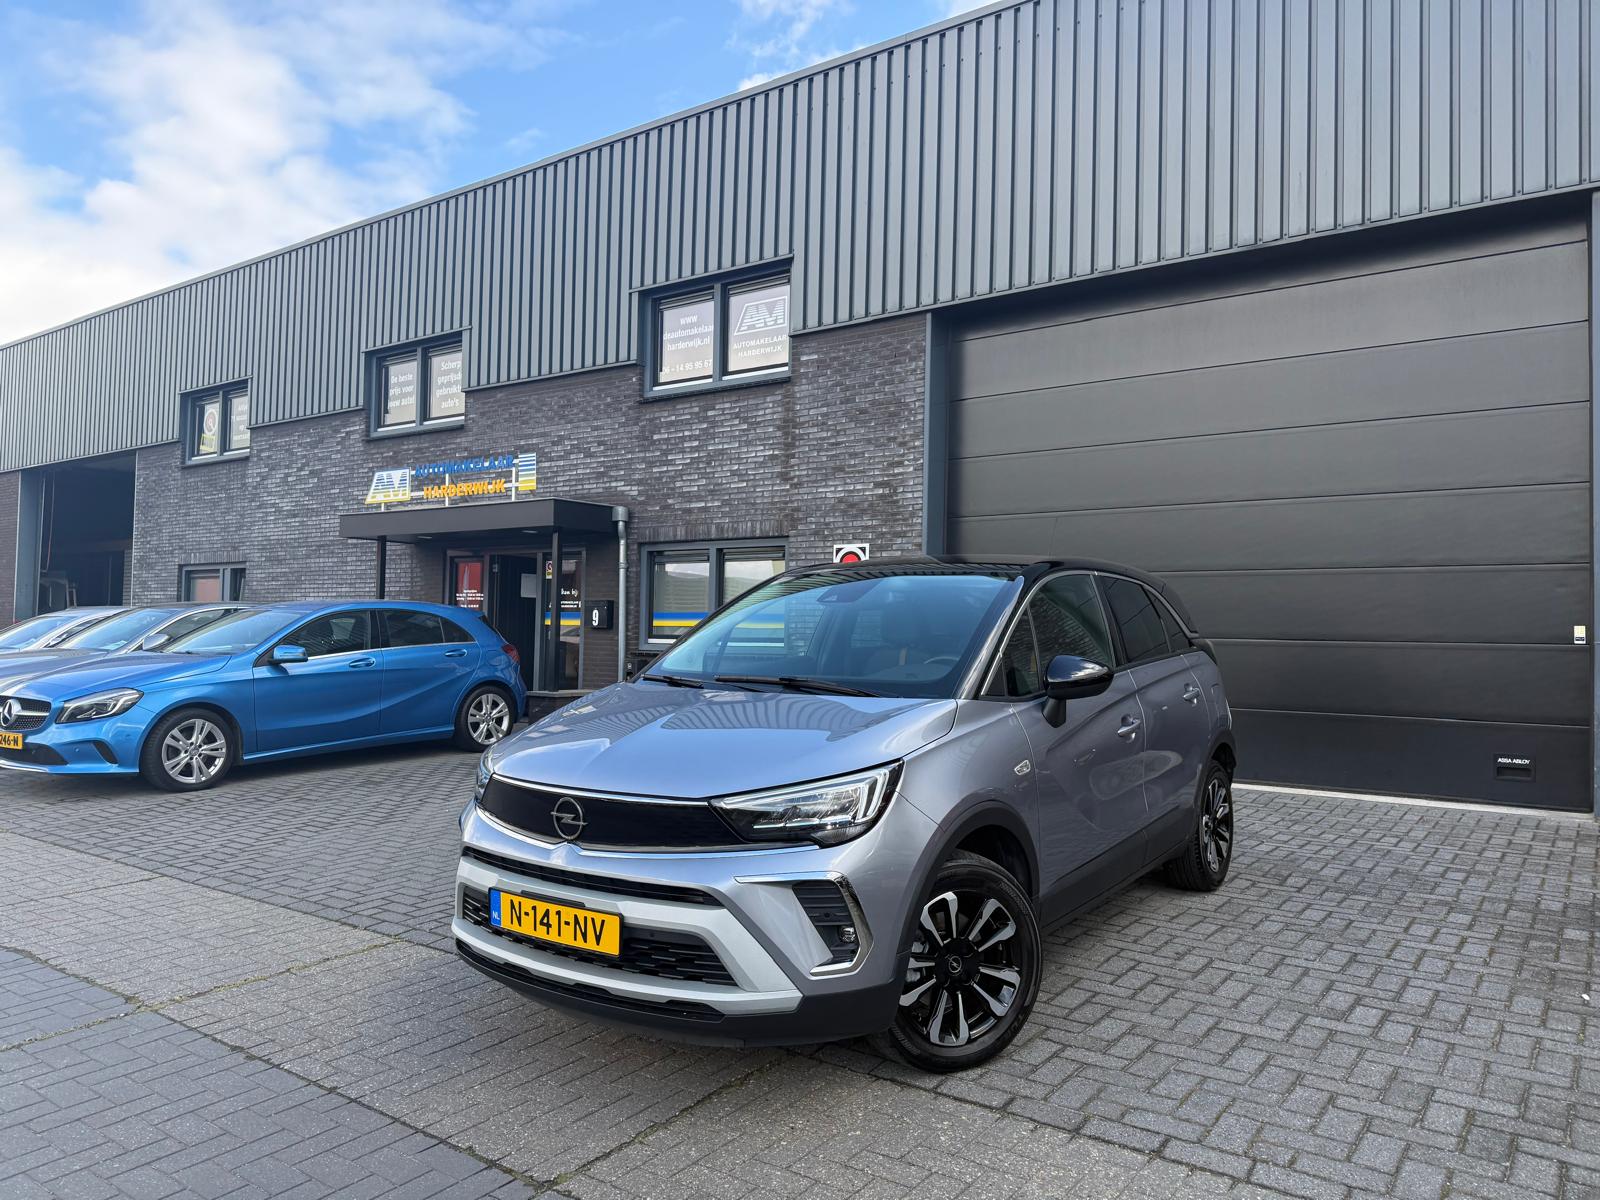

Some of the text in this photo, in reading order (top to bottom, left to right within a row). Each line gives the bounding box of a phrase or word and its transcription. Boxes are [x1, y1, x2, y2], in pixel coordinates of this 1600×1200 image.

[733, 334, 787, 349] AUTOMAKELAAR
[738, 345, 783, 357] HARDERWIJK
[414, 455, 514, 478] AUTOMAKELAAR
[423, 479, 506, 499] HARDERWIJK
[592, 609, 600, 627] 9
[492, 910, 500, 920] NL
[510, 898, 605, 946] N-141-NV
